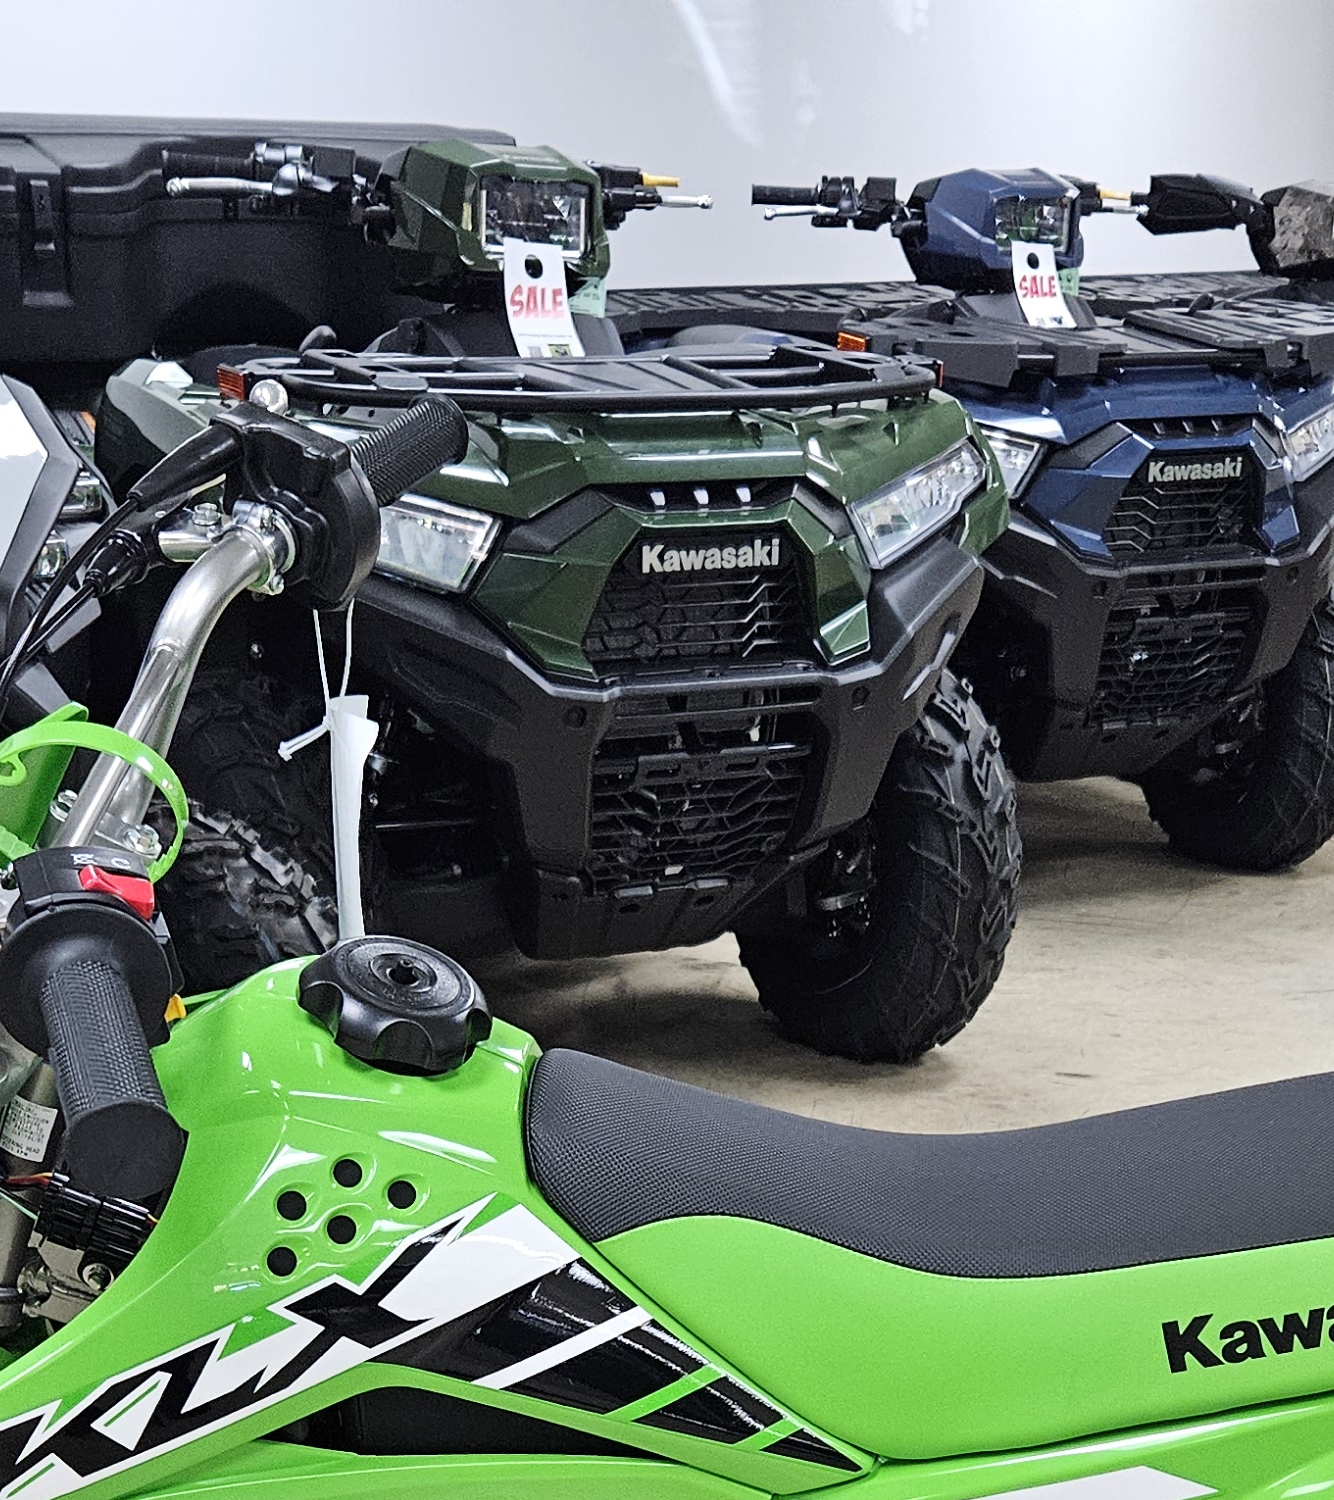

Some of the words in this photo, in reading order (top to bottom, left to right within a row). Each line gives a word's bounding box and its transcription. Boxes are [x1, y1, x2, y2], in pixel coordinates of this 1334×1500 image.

[510, 284, 564, 319] SALE
[1018, 275, 1057, 298] SALE
[1148, 457, 1242, 483] Kawasaki
[642, 538, 780, 574] Kawasaki
